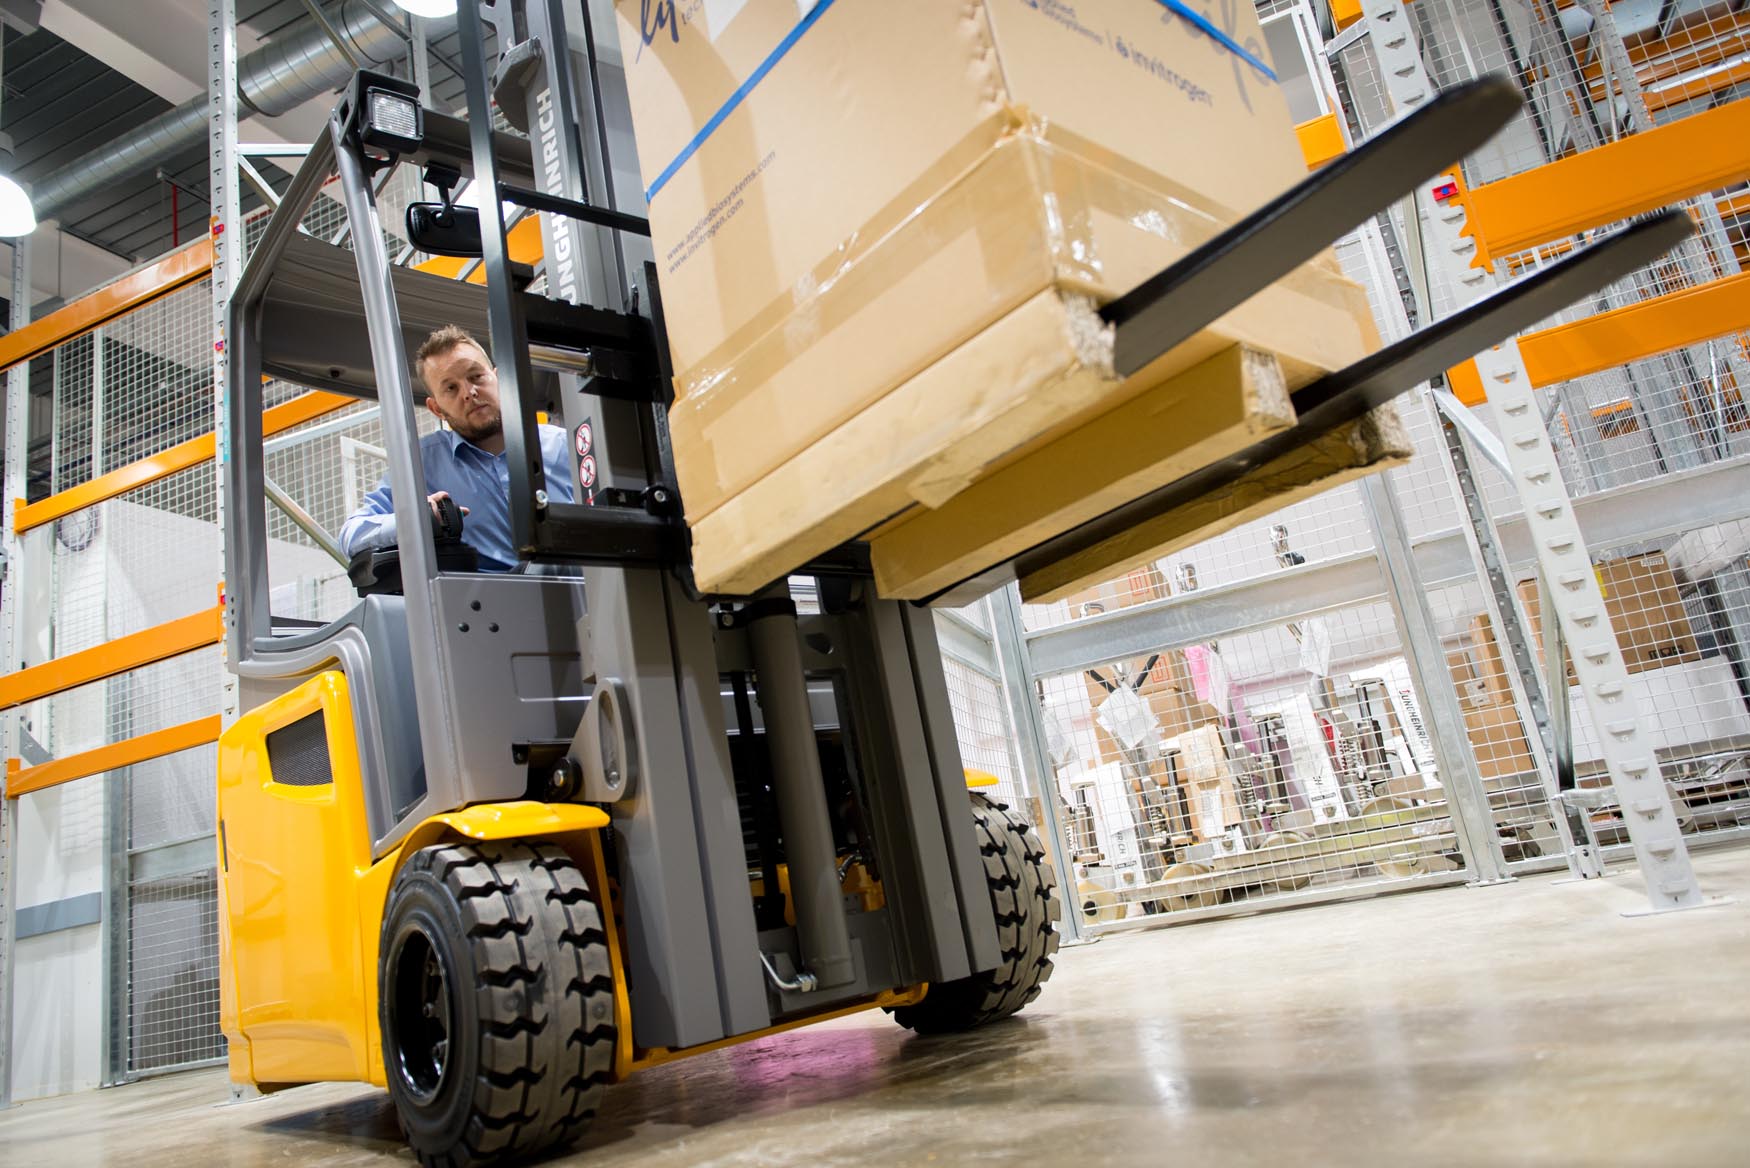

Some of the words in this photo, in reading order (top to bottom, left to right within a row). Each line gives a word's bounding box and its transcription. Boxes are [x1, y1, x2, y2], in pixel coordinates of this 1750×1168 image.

[536, 87, 577, 306] UNGHINRICH
[666, 150, 776, 261] www.appliedbiosystems.com
[669, 198, 744, 273] www.invitrogen.com
